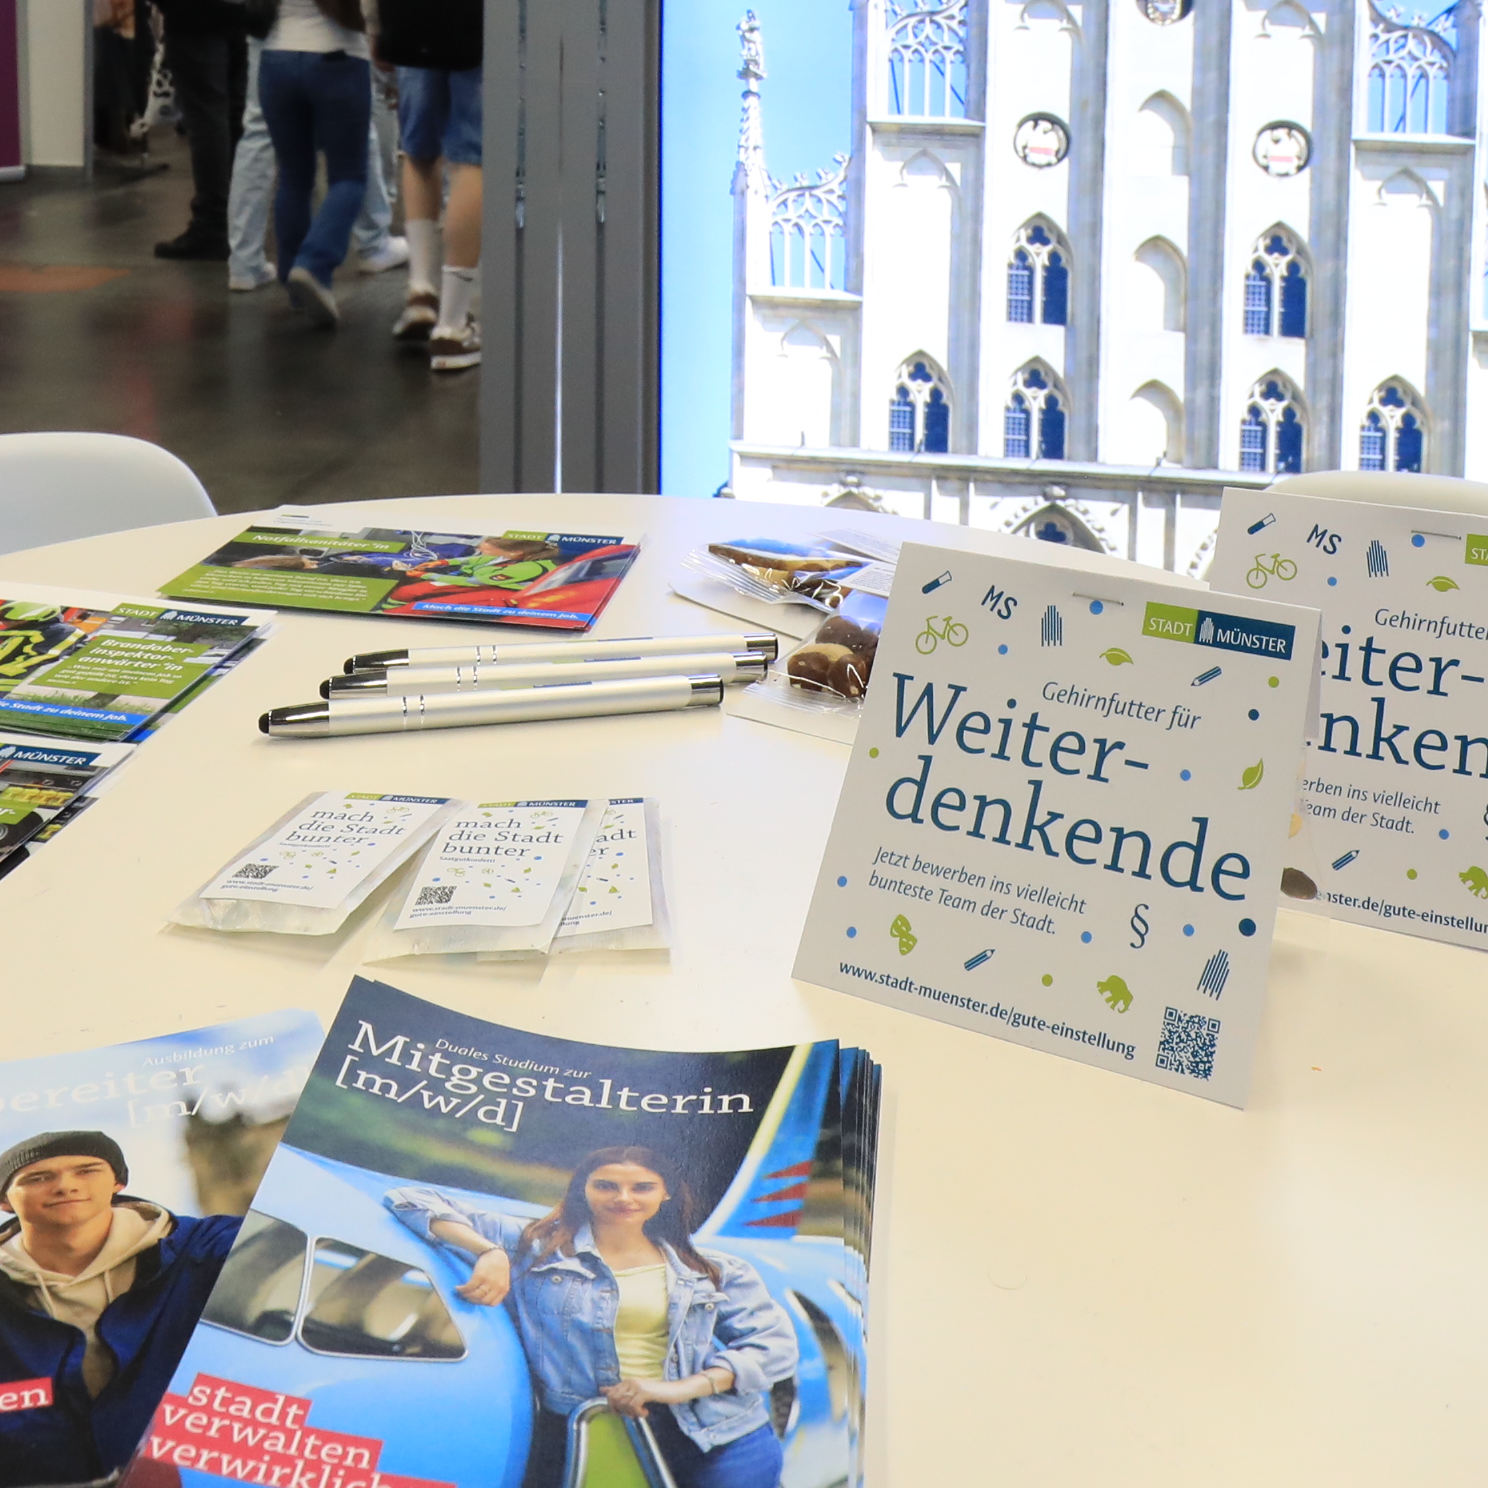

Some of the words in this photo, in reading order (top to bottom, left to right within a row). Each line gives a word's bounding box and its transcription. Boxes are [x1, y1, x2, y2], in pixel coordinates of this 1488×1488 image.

[253, 534, 369, 549] Notfallsanitäter
[561, 534, 617, 545] MÜNSTER
[1306, 522, 1342, 555] MS
[116, 606, 160, 618] STADT
[176, 614, 239, 626] MÜNSTER
[981, 585, 1019, 621] MS
[100, 638, 195, 655] Brandober-
[1148, 617, 1193, 638] STADT
[1215, 626, 1287, 654] MÜNSTER
[77, 655, 161, 670] anwärter
[89, 647, 174, 663] inspektor-
[11, 700, 47, 713] Stadt
[48, 707, 60, 715] zu
[60, 707, 103, 720] deinem
[103, 712, 128, 723] Job.
[1042, 680, 1167, 725] Gehirnfutter
[1166, 704, 1202, 731] für
[891, 671, 1150, 785] Weiter-
[14, 749, 87, 766] MÜNSTER
[392, 795, 438, 805] MÜNSTER
[1303, 778, 1342, 798] erben
[1347, 783, 1369, 802] ins
[1372, 789, 1441, 816] vielleicht
[298, 820, 335, 833] die
[340, 823, 407, 836] Stadt
[310, 810, 375, 822] mach
[455, 818, 522, 829] mach
[885, 753, 1251, 902] denkende
[1341, 806, 1368, 825] der
[1370, 813, 1415, 835] Stadt.
[285, 831, 369, 845] bunter
[441, 842, 531, 857] bunter
[448, 830, 487, 842] die
[494, 831, 564, 844] Stadt
[595, 828, 638, 843] adt
[872, 845, 910, 870] Jetzt
[911, 854, 987, 889] bewerben
[989, 874, 1013, 897] ins
[1016, 881, 1088, 915] vielleicht
[868, 870, 935, 903] bunteste
[936, 887, 978, 914] Team
[980, 899, 1009, 922] der
[1010, 906, 1057, 936] Stadt.
[839, 961, 1137, 1061] www.stadt-muenster.de/gute-einstellung
[141, 1041, 235, 1068] Ausbildung
[238, 1034, 275, 1052] zum
[435, 1038, 489, 1061] Duales
[492, 1052, 560, 1075] Studium
[563, 1067, 592, 1080] zur
[347, 1019, 754, 1115] Mitgestalterin
[334, 1055, 523, 1132] [m/w/d]
[187, 1384, 305, 1430] stadt
[161, 1403, 371, 1469] verwalten
